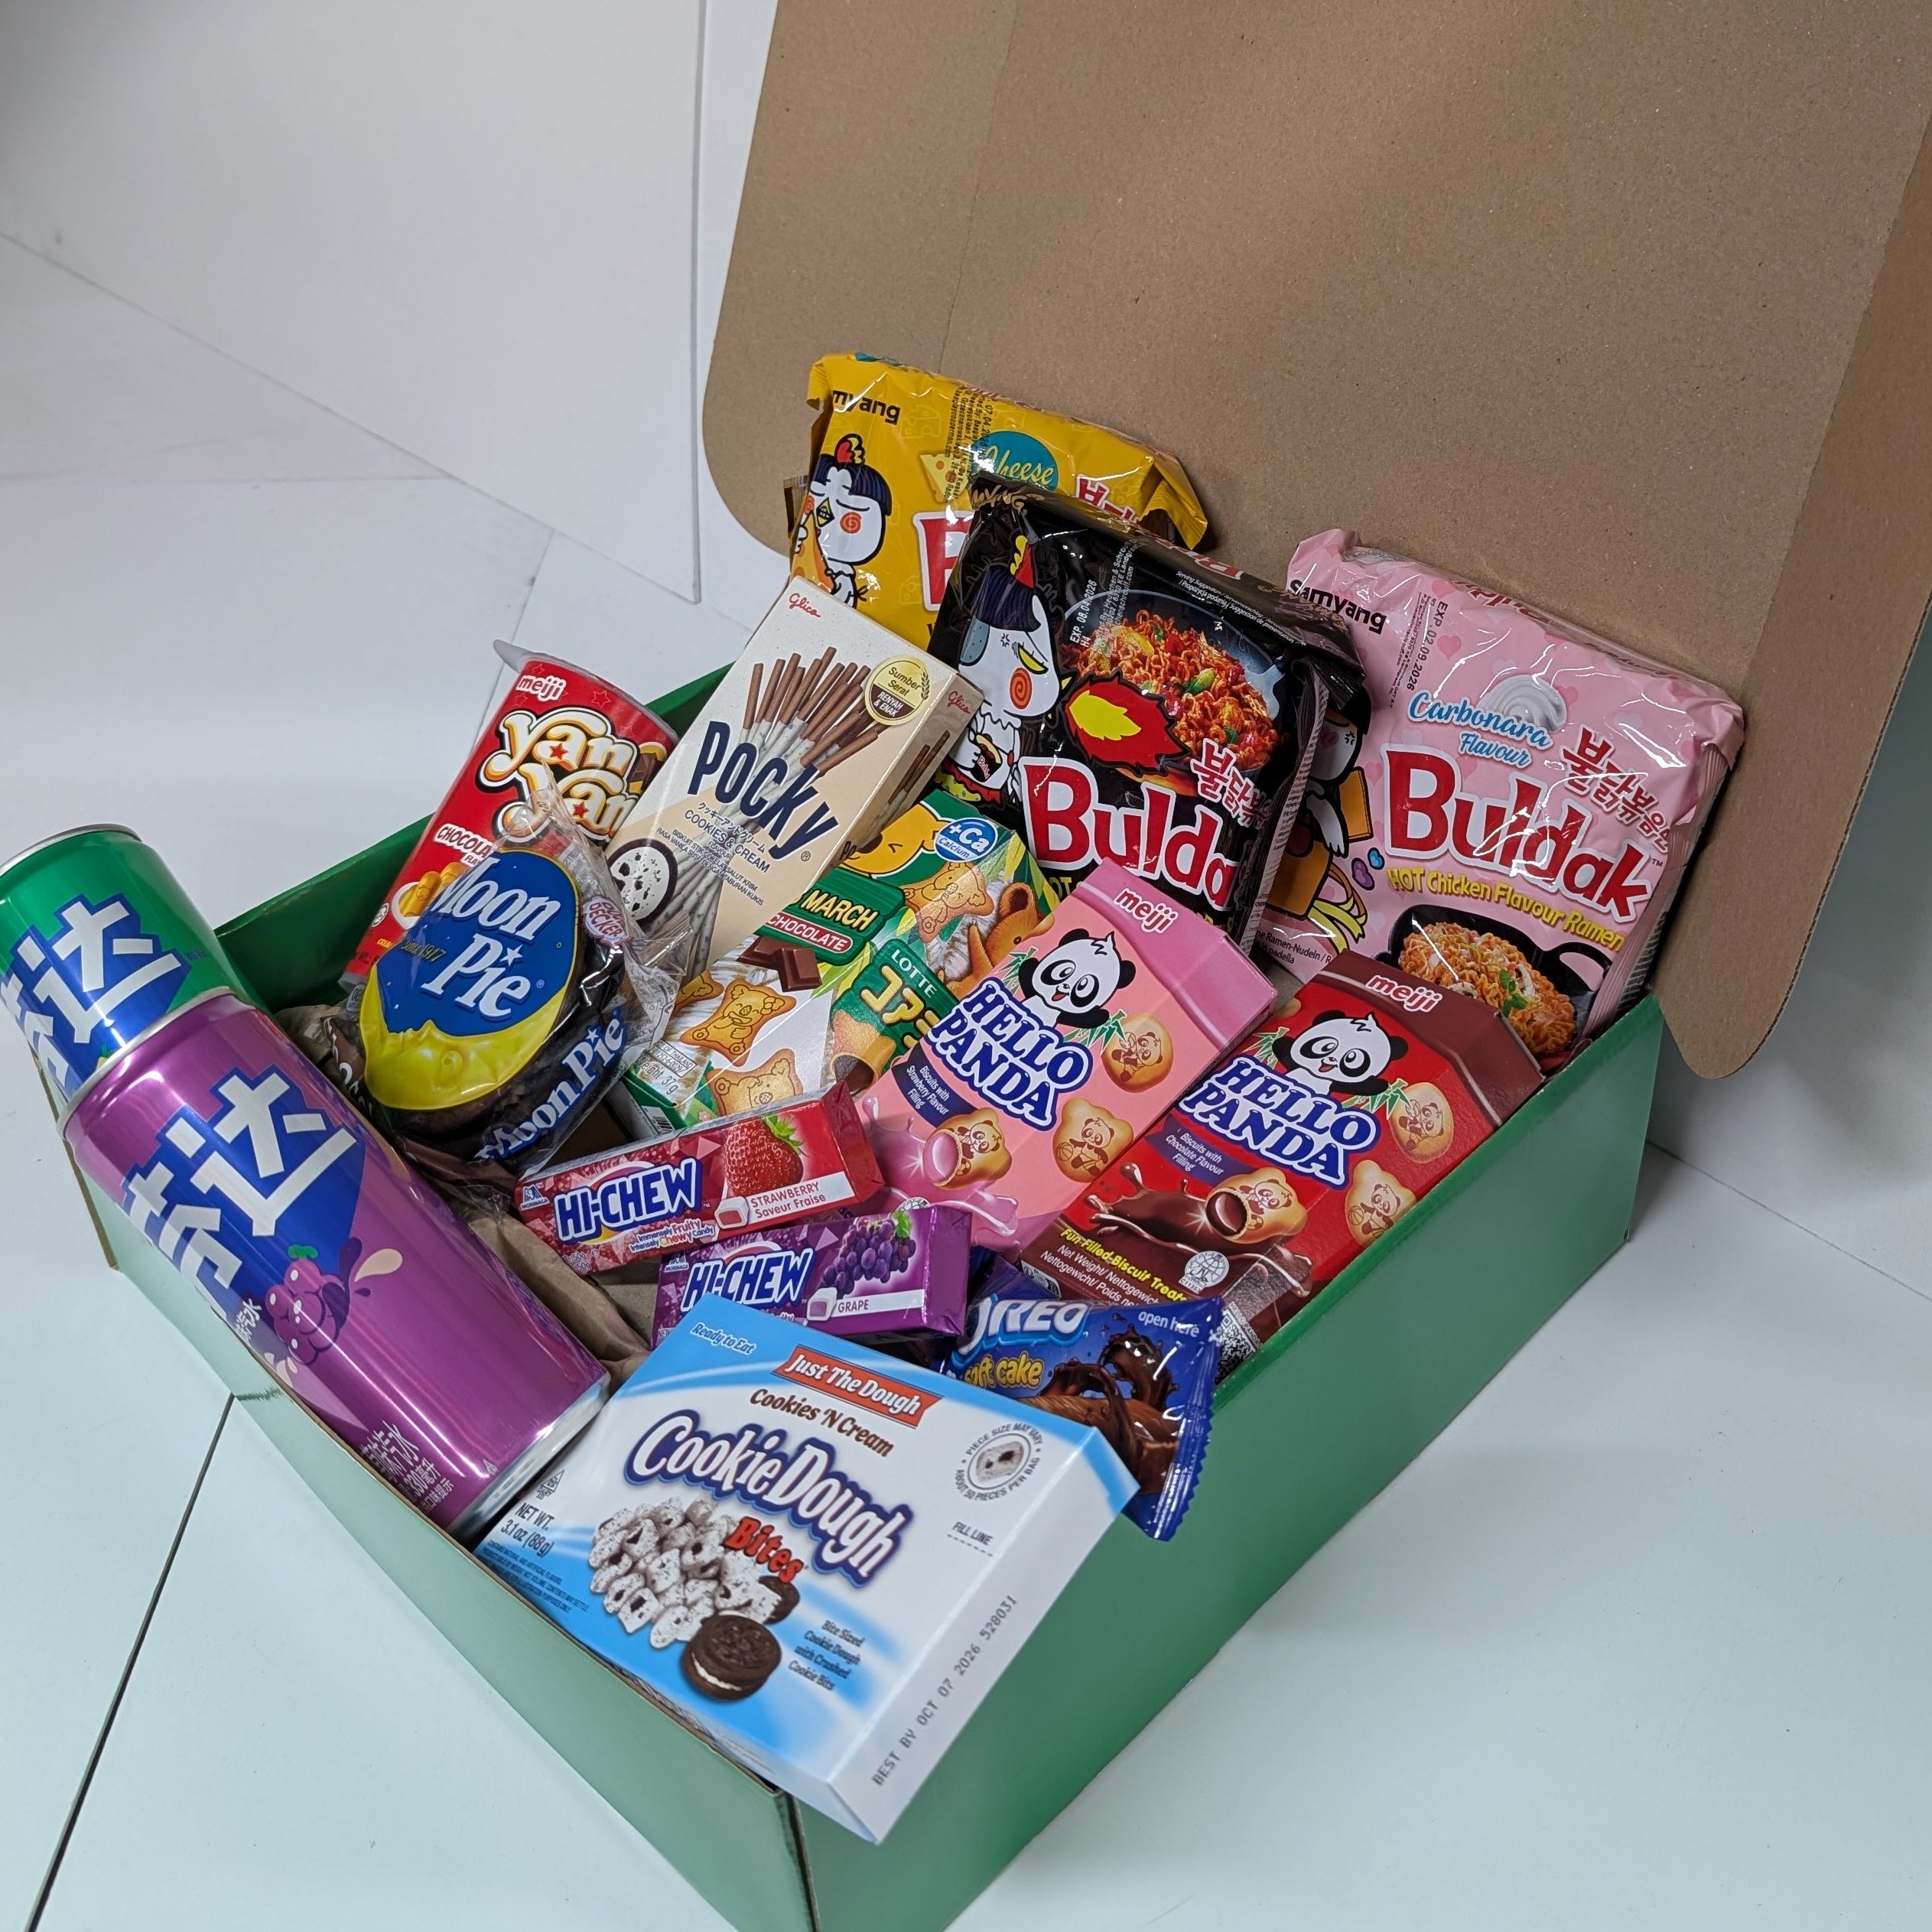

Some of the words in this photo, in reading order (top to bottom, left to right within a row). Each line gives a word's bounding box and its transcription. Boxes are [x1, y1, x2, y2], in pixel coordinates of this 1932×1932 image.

[831, 389, 901, 425] myang
[788, 592, 821, 618] Glico
[1075, 579, 1098, 623] 08.04.2026
[1429, 600, 1449, 629] EXP.
[1069, 623, 1084, 642] EXP.
[886, 665, 923, 691] Sumber
[1405, 629, 1437, 691] 02.09.2026
[516, 675, 566, 701] meiji
[877, 690, 905, 711] RENYAH
[886, 678, 911, 697] Serat
[878, 701, 899, 717] ENAK
[1408, 691, 1553, 751] Carbonara
[1459, 731, 1532, 768] Flavour
[436, 825, 493, 858] CHOCOLA
[683, 808, 727, 844] COOKIES
[733, 843, 769, 873] CREAM
[707, 840, 732, 860] FLAVOUR
[938, 836, 969, 858] Calcium
[1020, 759, 1241, 910] Bulda
[1384, 746, 1651, 921] Buldak
[656, 827, 672, 841] RASA
[669, 836, 689, 853] VANILA
[722, 873, 748, 895] TABURAN
[746, 891, 764, 906] KUKIS
[672, 828, 692, 846] BISKUIT
[691, 842, 704, 854] STIK
[726, 867, 743, 882] SALUT
[742, 878, 757, 892] KRIM
[801, 886, 878, 932] MARCH
[1114, 889, 1178, 934] meiji
[1387, 867, 1425, 892] HOT
[1427, 871, 1491, 901] Chicken
[1495, 881, 1566, 927] Flavour
[1566, 909, 1625, 951] Ramen
[769, 912, 852, 952] CHOCOLATE
[1264, 932, 1322, 961] Ramen-Nudeln
[421, 932, 532, 1019] Pie
[890, 948, 938, 999] LOTTE
[1366, 975, 1442, 1013] meiji
[963, 980, 1091, 1088] HELLO
[658, 1073, 681, 1098] 37g
[919, 1064, 938, 1090] Biscuits
[935, 1085, 951, 1101] with
[929, 1014, 1058, 1128] PANDA
[905, 1087, 927, 1110] Filling
[906, 1064, 930, 1098] Strawberry
[925, 1092, 949, 1116] Flavour
[1217, 1057, 1378, 1149] HELLO
[1163, 1133, 1198, 1162] Chocolate
[1195, 1158, 1224, 1175] Flavour
[1179, 1088, 1346, 1186] PANDA
[1179, 1130, 1208, 1155] Biscuits
[1205, 1147, 1223, 1165] with
[1171, 1151, 1195, 1173] Filling
[553, 1158, 704, 1246] HI-CHEW
[750, 1182, 820, 1209] STRAWBERRY
[754, 1200, 792, 1220] Saveur
[793, 1192, 827, 1212] Fraise
[659, 1230, 692, 1250] Chewy
[672, 1217, 702, 1237] Fruity
[1057, 1244, 1075, 1259] Net
[1072, 1252, 1108, 1278] Weight/
[681, 1249, 816, 1311] HI-CHEW
[1094, 1280, 1124, 1302] Poids
[838, 1298, 870, 1314] GRAPE
[1138, 1310, 1168, 1328] open
[691, 1322, 726, 1346] Ready
[733, 1337, 756, 1355] Eat
[786, 1354, 826, 1385] Just
[828, 1366, 863, 1394] The
[861, 1379, 922, 1416] Dough
[996, 1351, 1045, 1388] cake
[750, 1388, 822, 1423] Cookies
[837, 1416, 895, 1458] Cream
[965, 1433, 990, 1455] PIECE
[991, 1423, 1011, 1436] SIZE
[1013, 1423, 1031, 1431] MAY
[1029, 1427, 1042, 1444] VARY
[974, 1487, 1007, 1500] PIECES
[1008, 1475, 1026, 1490] PER
[1024, 1457, 1039, 1474] BAG
[514, 1501, 540, 1521] NET
[535, 1510, 556, 1531] WT.
[952, 1520, 971, 1536] FILL
[970, 1527, 994, 1546] LINE
[500, 1518, 515, 1536] 3.1
[512, 1527, 527, 1543] oz
[522, 1531, 555, 1559] (88g)
[723, 1516, 805, 1583] Bites
[803, 1628, 835, 1651] Cookie
[830, 1642, 862, 1668] Dough
[788, 1658, 819, 1681] Cookie
[871, 1750, 902, 1786] BEST
[901, 1729, 917, 1749] BY
[916, 1701, 938, 1726] OCT
[938, 1679, 955, 1698] 07
[955, 1644, 982, 1677] 2026
[980, 1595, 1017, 1640] 528031
